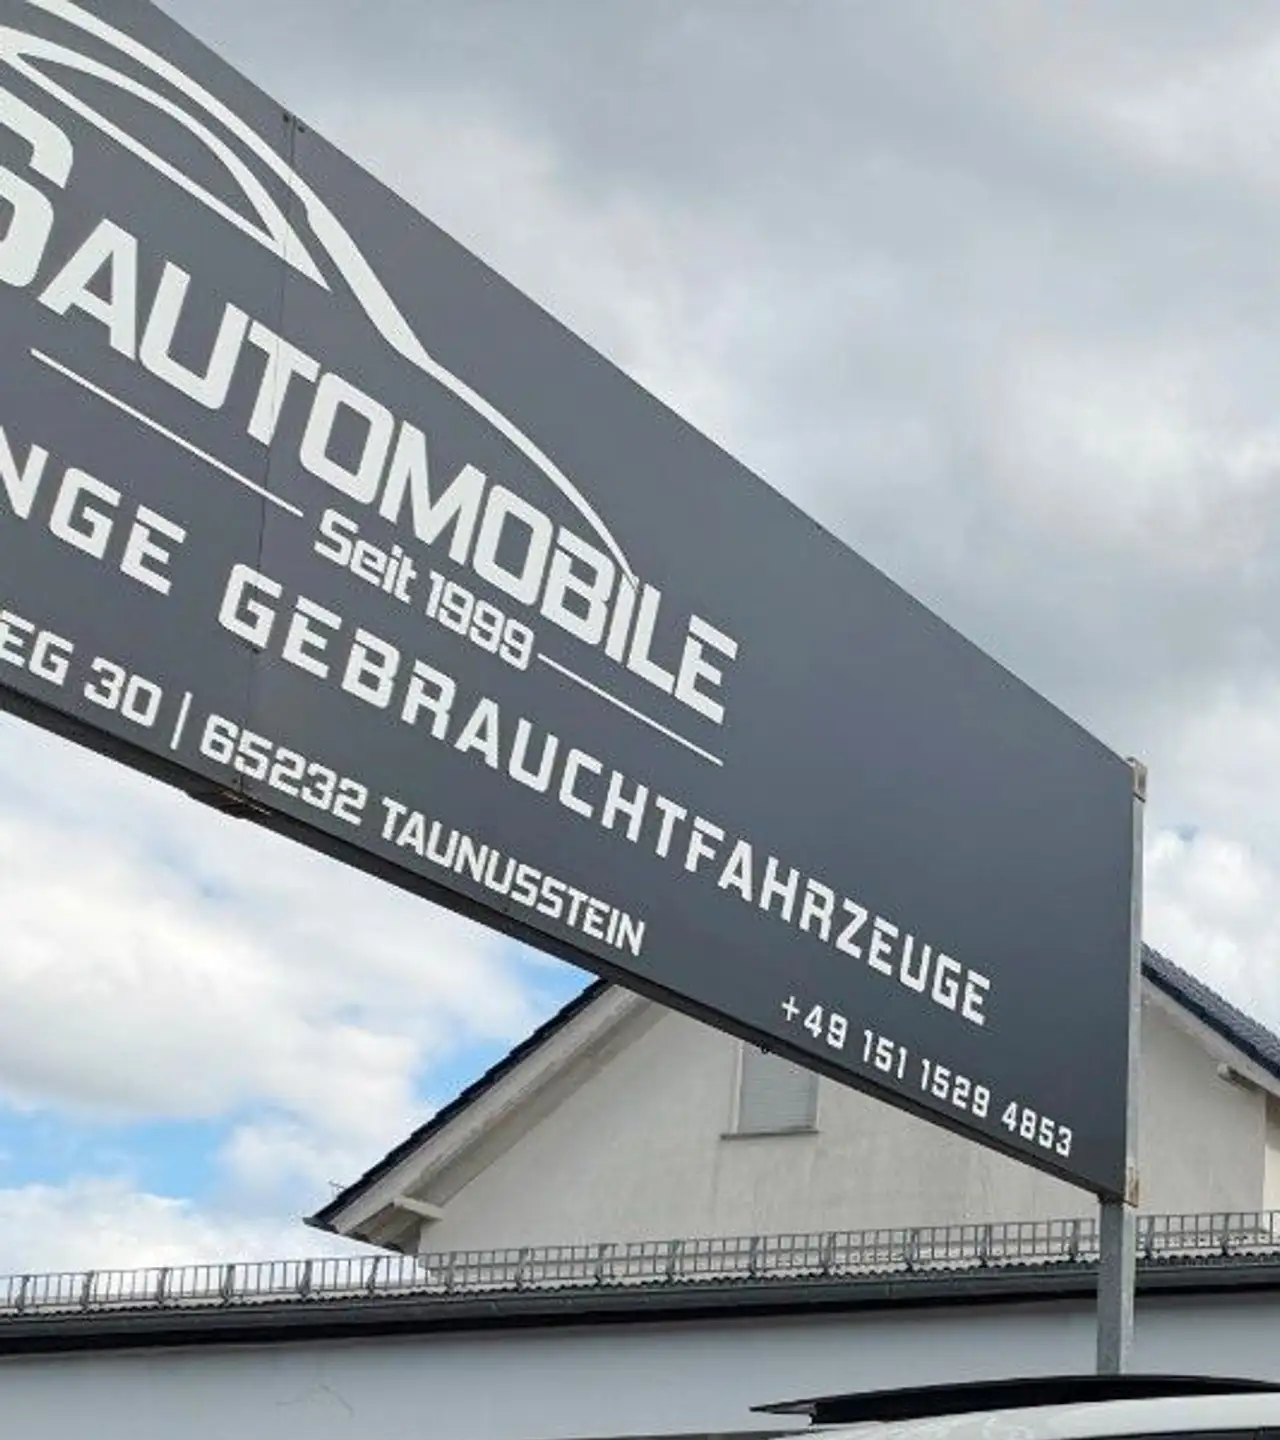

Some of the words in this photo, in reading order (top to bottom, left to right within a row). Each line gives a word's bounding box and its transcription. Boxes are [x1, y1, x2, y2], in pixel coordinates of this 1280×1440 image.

[314, 509, 416, 603] Seit
[426, 571, 534, 670] 1999
[84, 658, 162, 726] 30
[200, 715, 367, 824] 65232
[383, 797, 644, 955] TAUNUSSTEIN
[219, 564, 989, 1025] GEBRAUCHTFAHRZEUGE
[783, 997, 847, 1048] +49
[864, 1030, 906, 1078] 151
[922, 1059, 989, 1117] 1529
[1003, 1103, 1071, 1156] 4853
